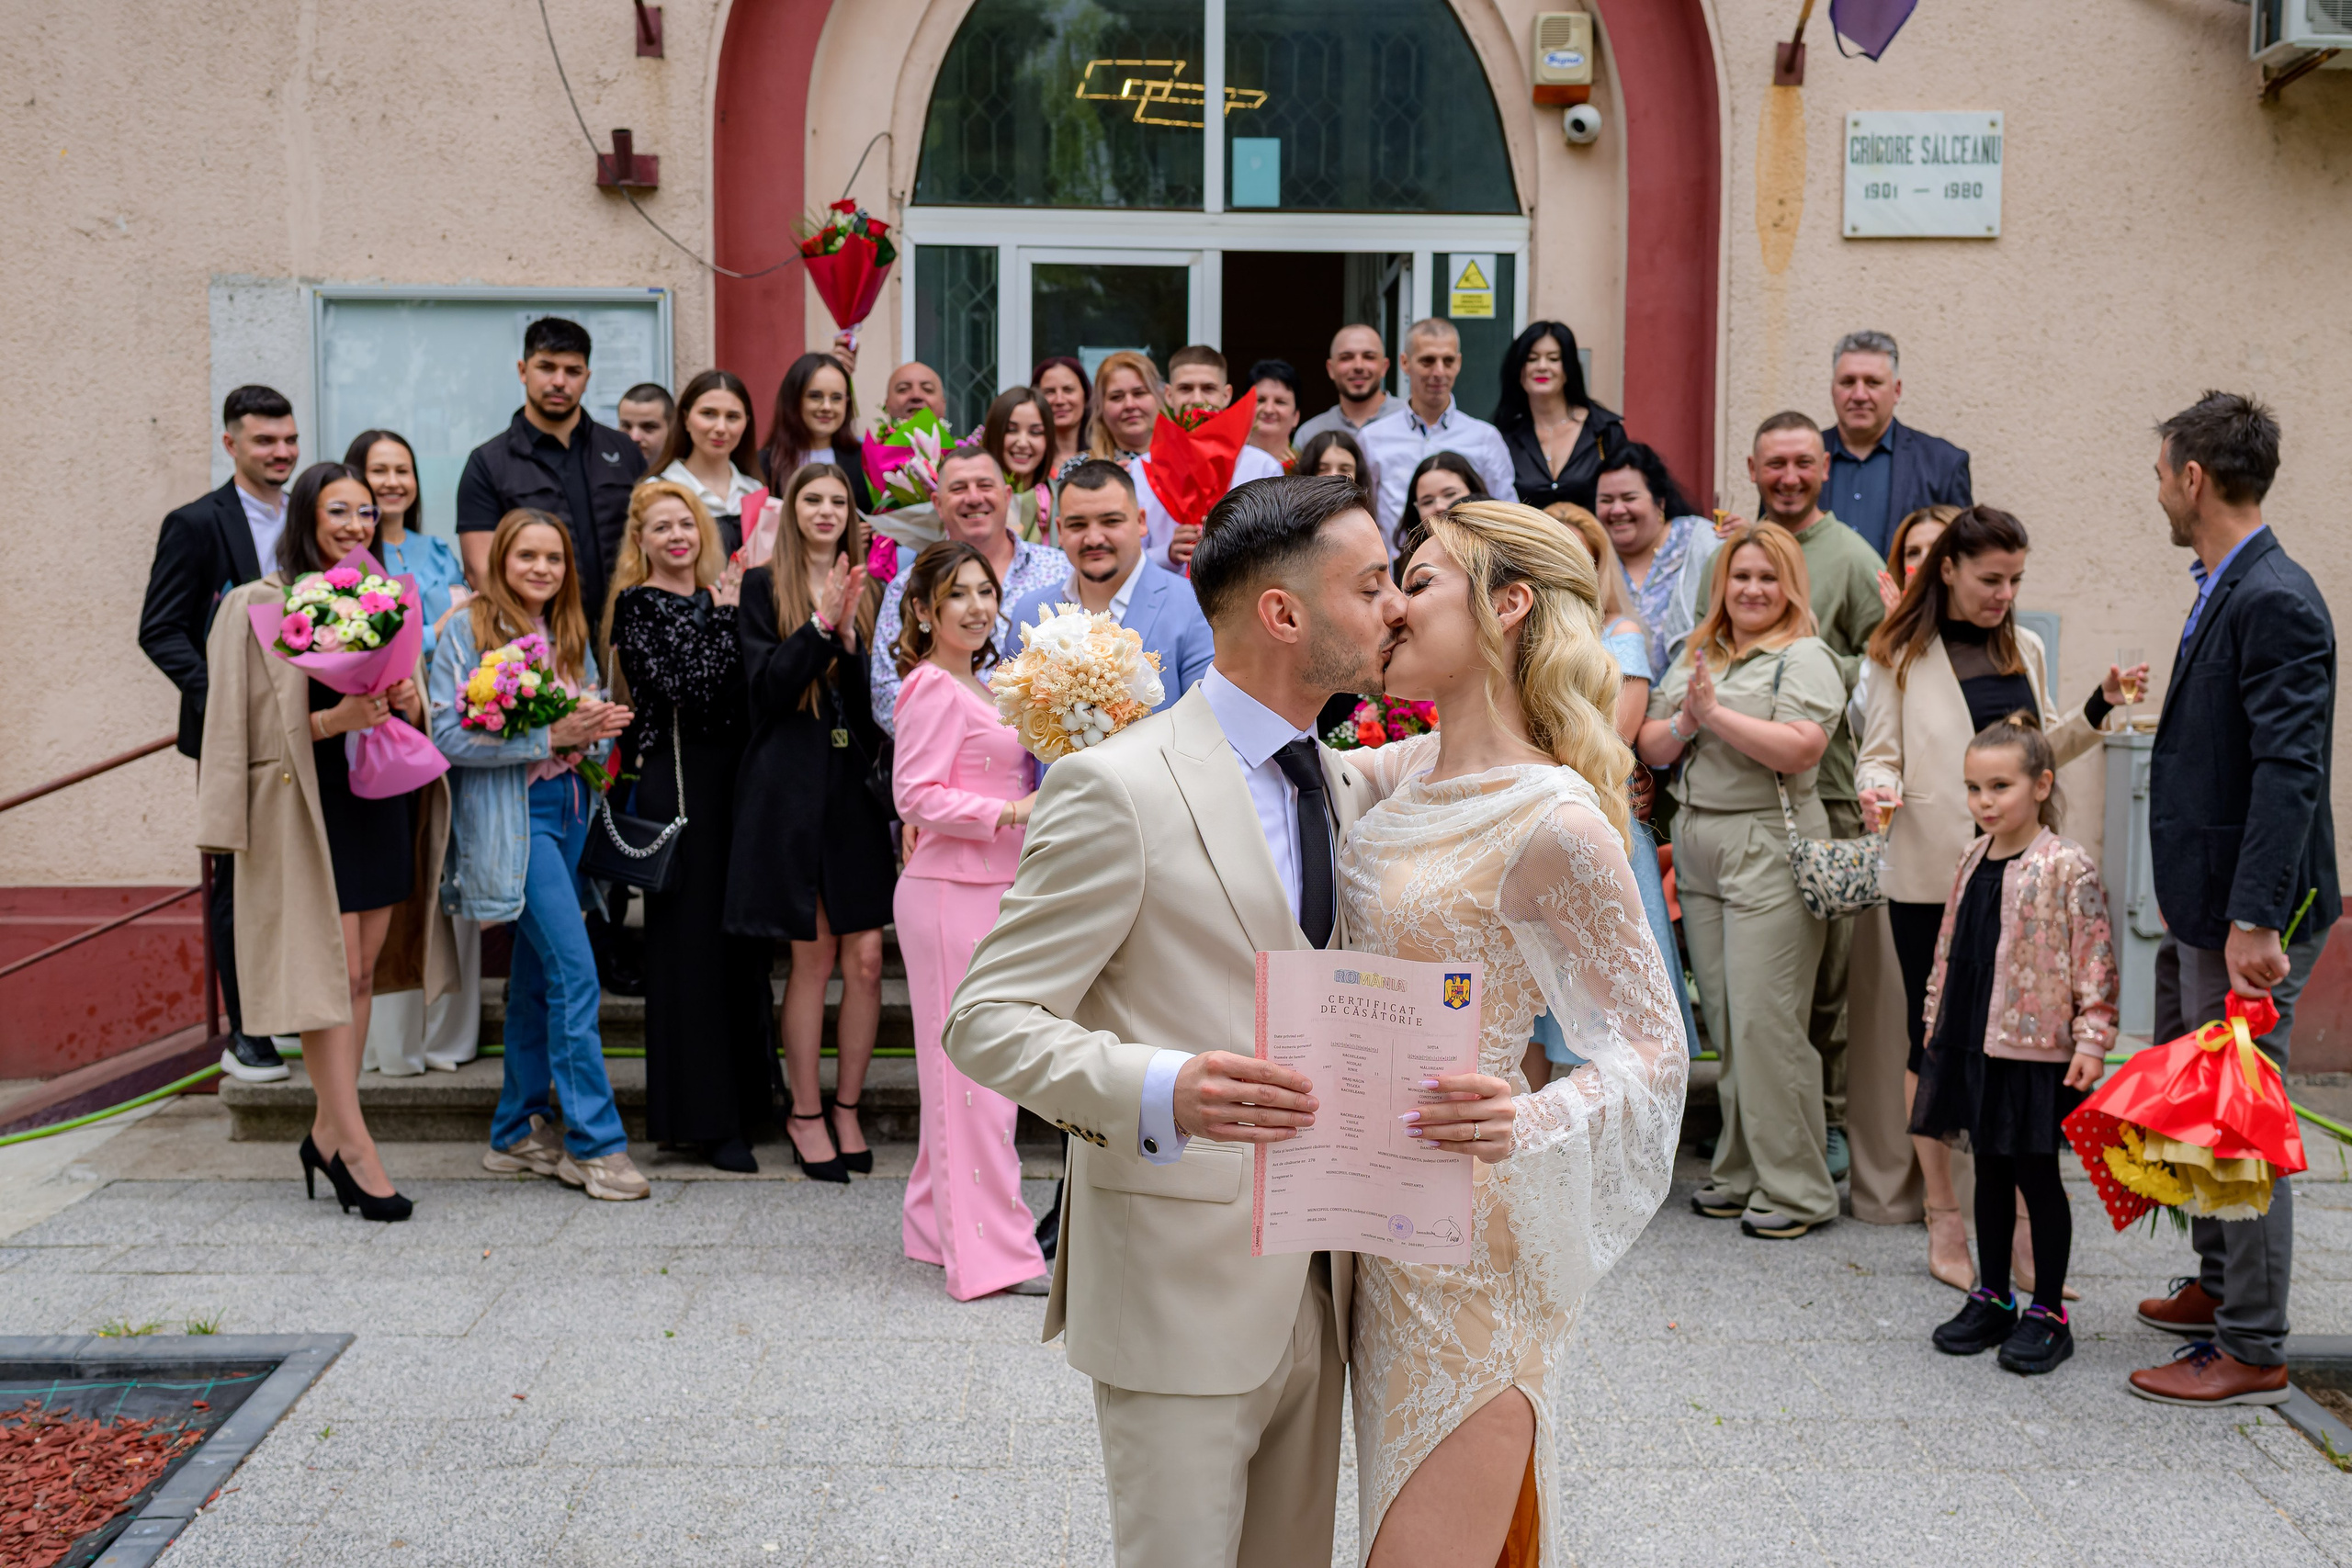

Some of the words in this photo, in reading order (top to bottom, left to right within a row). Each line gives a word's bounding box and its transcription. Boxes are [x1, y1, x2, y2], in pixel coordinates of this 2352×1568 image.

[1864, 182, 1899, 199] 1901
[1943, 182, 1984, 199] 1980
[1334, 969, 1407, 993] ROMÂNIA
[1320, 1004, 1337, 1014] DE
[1343, 1005, 1422, 1027] CĂSĂTORIE
[1329, 995, 1416, 1015] CERTIFICAT
